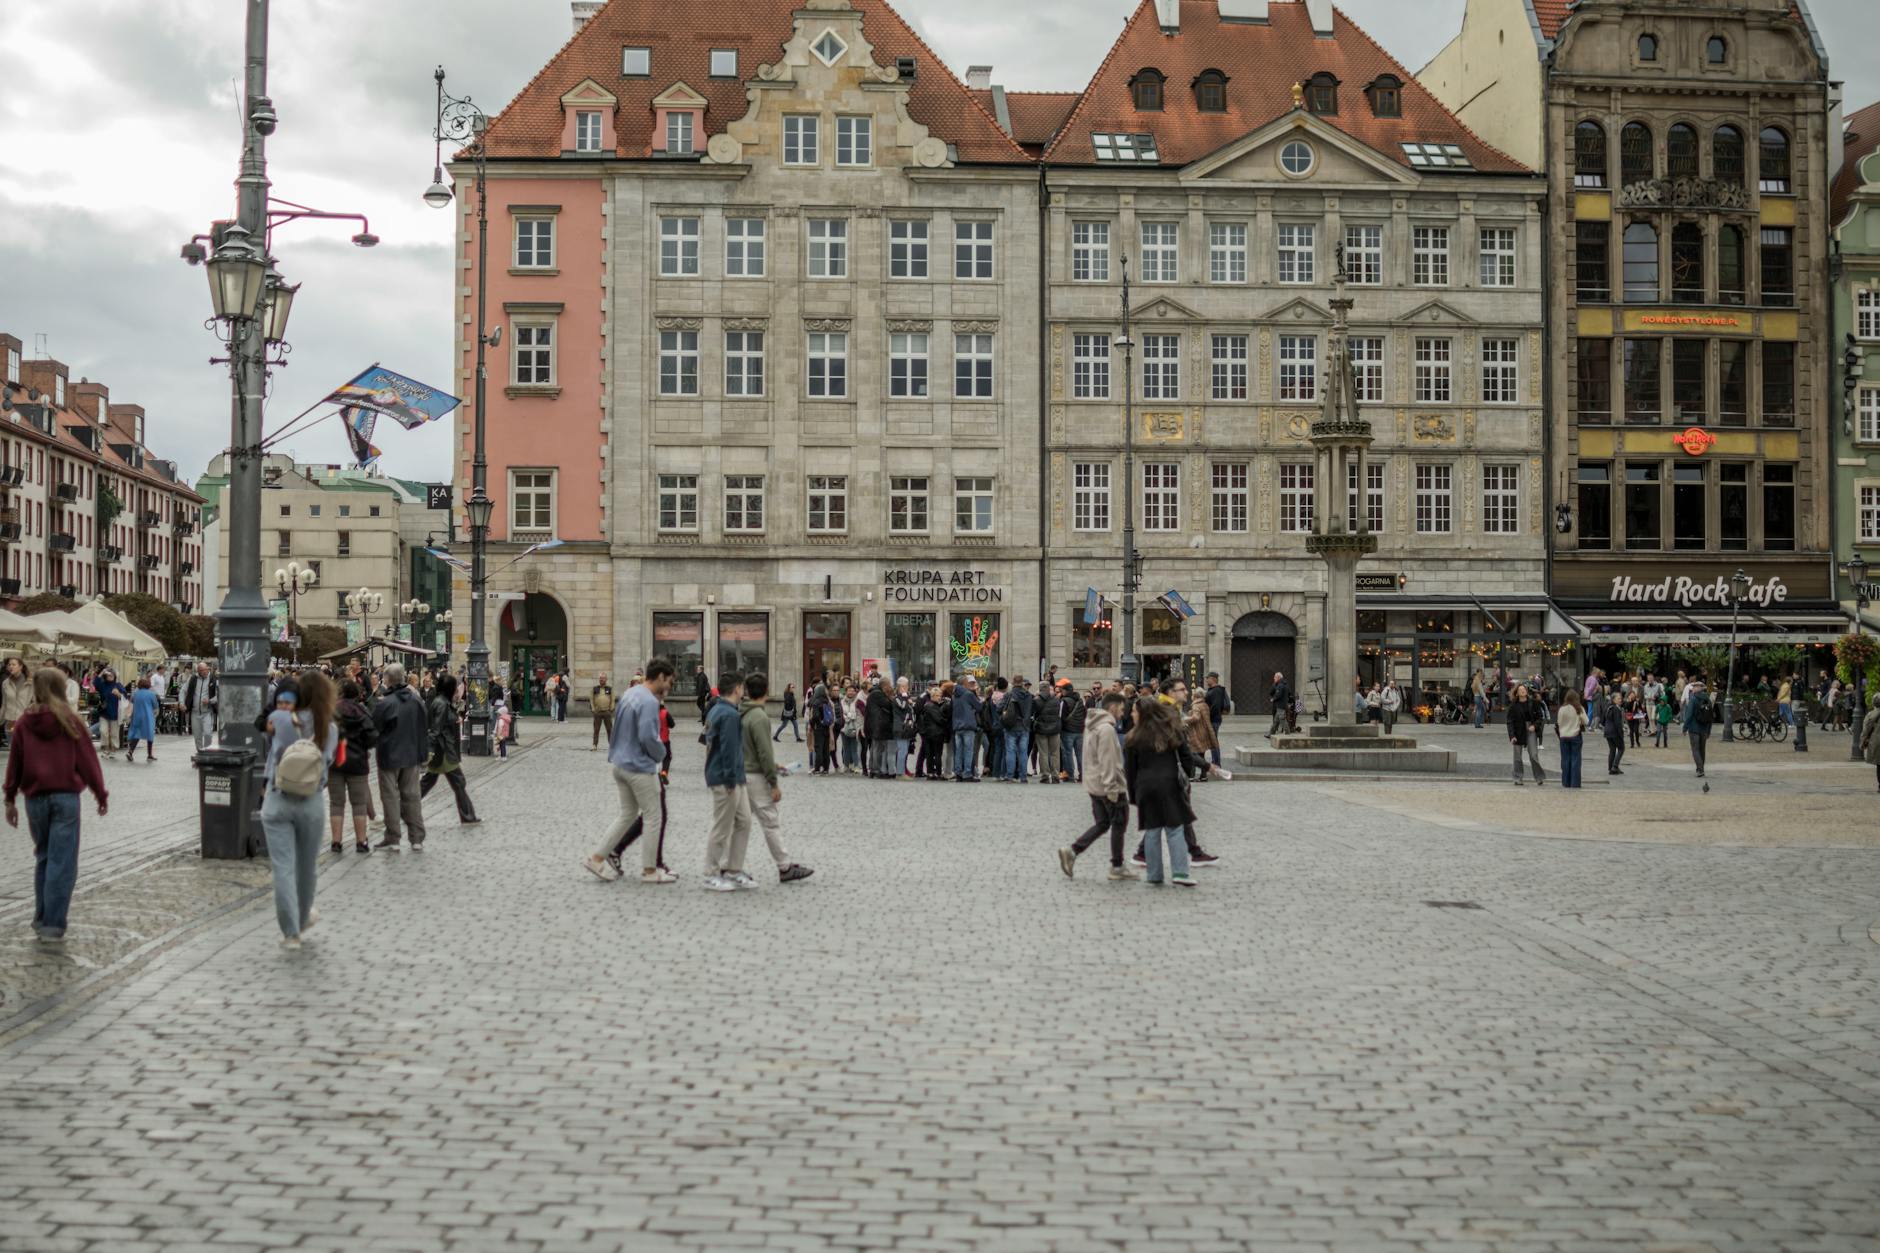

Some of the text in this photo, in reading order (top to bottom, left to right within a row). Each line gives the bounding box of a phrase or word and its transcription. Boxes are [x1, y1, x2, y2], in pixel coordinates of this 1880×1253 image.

[432, 488, 447, 498] KA
[432, 498, 439, 507] F
[884, 570, 985, 584] KRUPA ART
[885, 587, 1002, 601] FOUNDATION
[1610, 576, 1672, 601] Hard
[1674, 576, 1730, 607] Rock
[1151, 619, 1171, 631] 26
